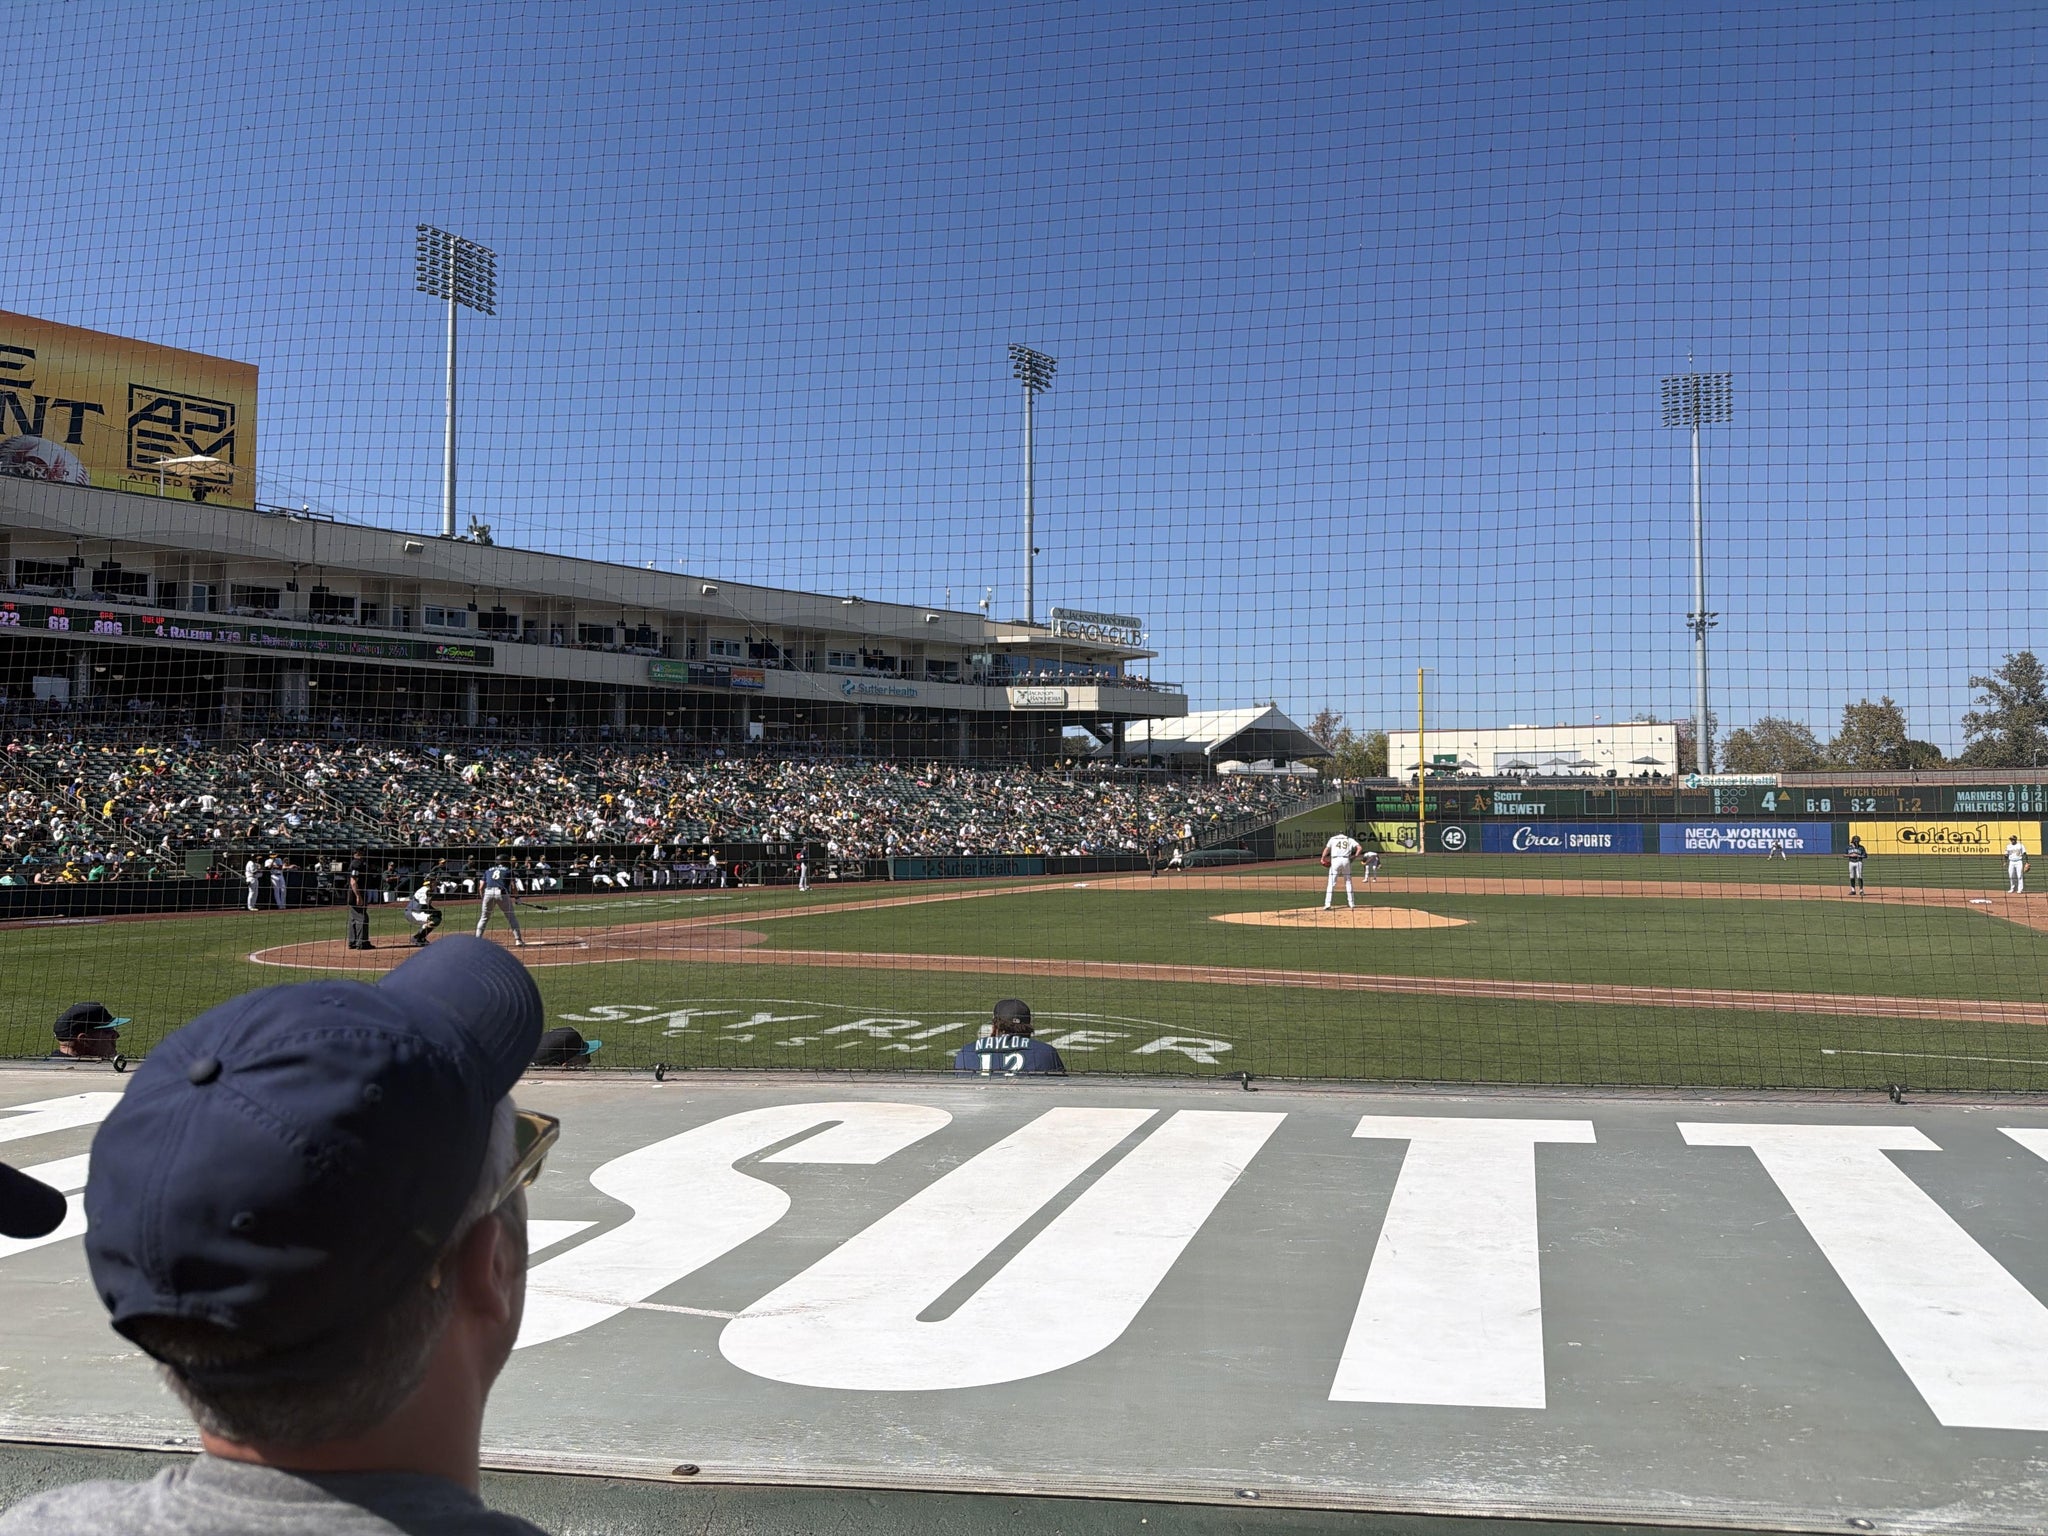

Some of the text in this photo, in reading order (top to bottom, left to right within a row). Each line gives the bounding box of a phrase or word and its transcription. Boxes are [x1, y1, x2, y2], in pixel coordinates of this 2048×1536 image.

[136, 392, 153, 401] THE
[128, 473, 147, 482] AT
[152, 476, 183, 487] RED
[189, 482, 233, 496] HWK
[48, 616, 69, 631] 68
[156, 617, 166, 625] UP
[1053, 619, 1142, 646] LEGACY CLUB
[858, 683, 918, 697] Sutter Health
[1702, 776, 1777, 786] Sutter Health
[1714, 788, 1721, 797] B
[1843, 787, 1901, 797] PITCH COUNT
[1957, 791, 2003, 801] MARINERS
[2034, 791, 2042, 801] 2
[1714, 797, 1721, 805] S
[1761, 791, 1778, 812] 4
[1953, 802, 2004, 813] ATHLETICS
[2007, 802, 2015, 812] 2
[1357, 827, 1417, 842] CALL 811
[1445, 832, 1461, 844] 42
[1512, 826, 1612, 851] Circa SPORTS
[1685, 828, 1798, 838] NECA WORKING
[1685, 838, 1804, 849] IBEW TOGETHER
[1931, 845, 1990, 853] Credit Union
[937, 859, 1019, 876] Sutter Health
[492, 869, 501, 880] 8
[557, 1005, 824, 1029] SKY
[975, 1034, 1030, 1050] NAYLOR
[980, 1052, 1024, 1076] 12
[503, 1102, 2048, 1430] SUTT
